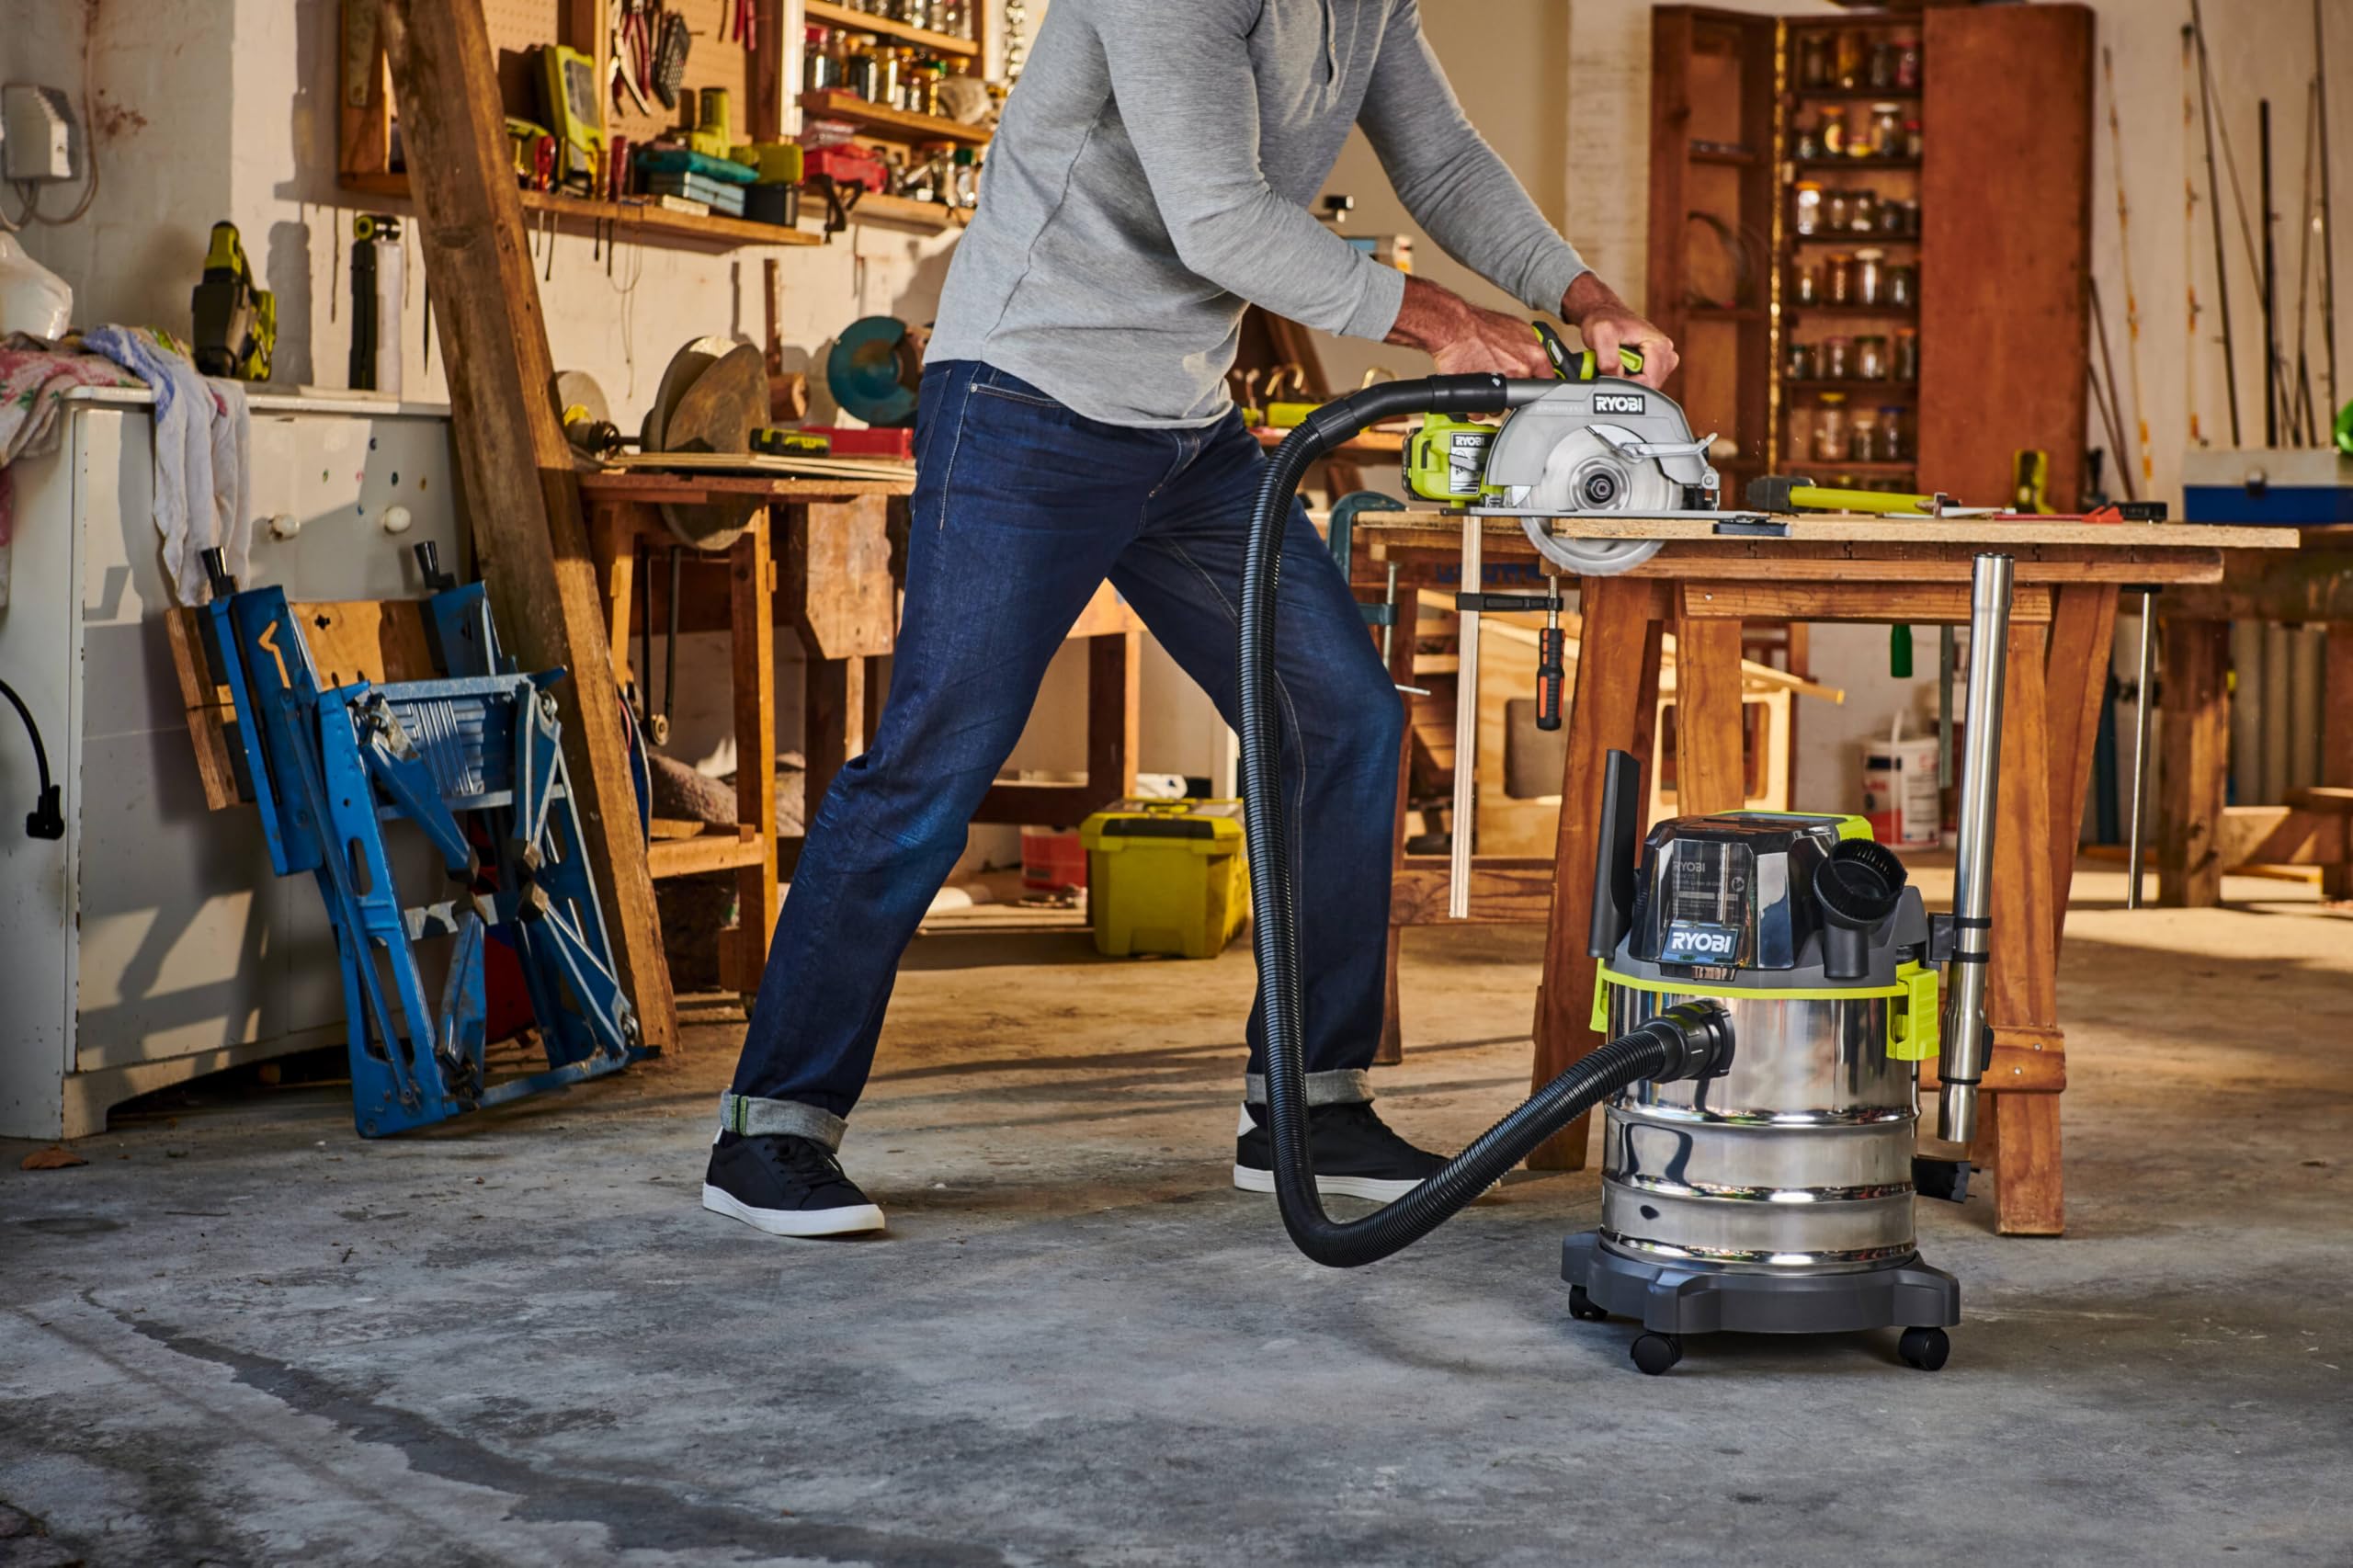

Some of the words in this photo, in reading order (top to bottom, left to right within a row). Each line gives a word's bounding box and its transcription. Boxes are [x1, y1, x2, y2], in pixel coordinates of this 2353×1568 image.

[1595, 395, 1643, 412] RYOBI
[1455, 436, 1485, 447] RYOBI
[1672, 861, 1705, 872] RYOBI
[1671, 931, 1732, 953] RYOBI
